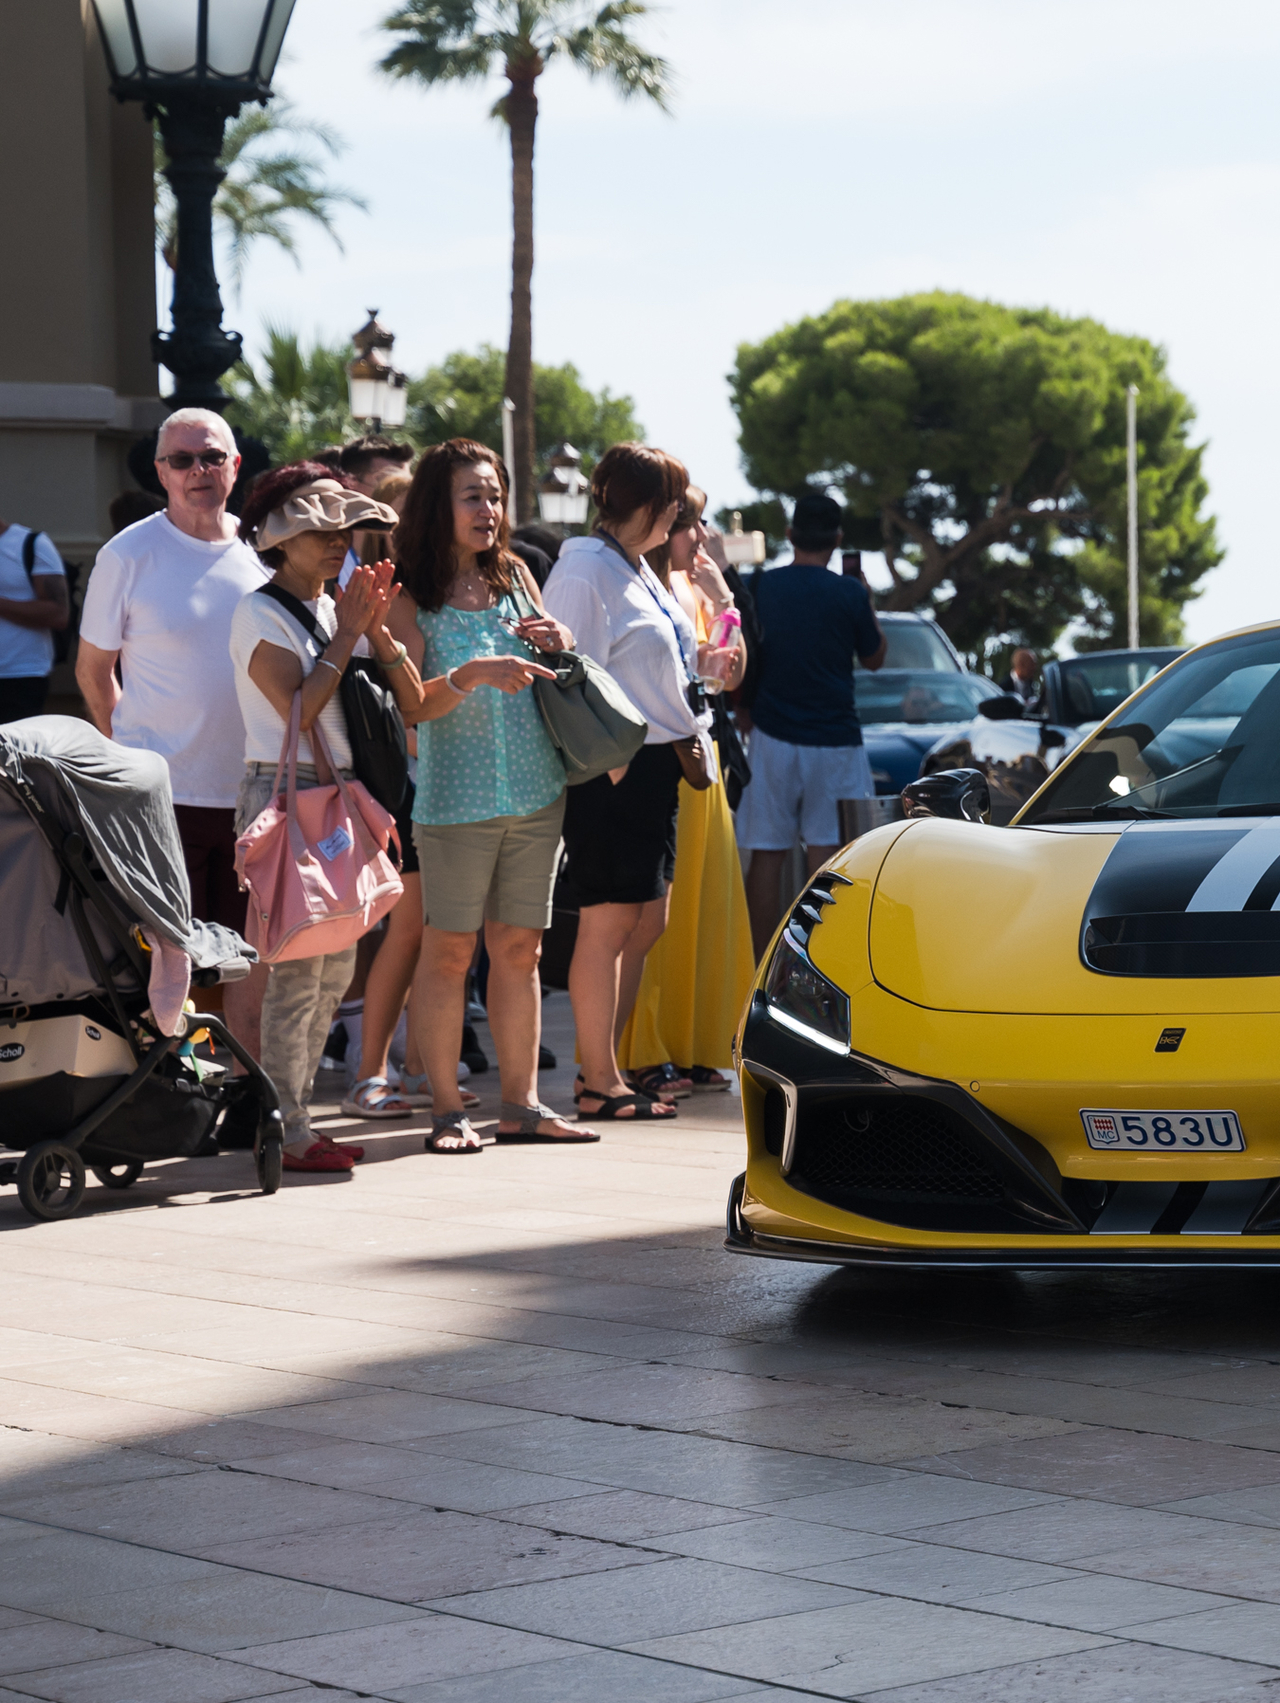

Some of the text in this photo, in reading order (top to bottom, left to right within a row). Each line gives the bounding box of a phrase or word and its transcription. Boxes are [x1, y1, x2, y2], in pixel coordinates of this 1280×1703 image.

[86, 1027, 101, 1040] Scholl
[1097, 1116, 1233, 1147] MC 583U
